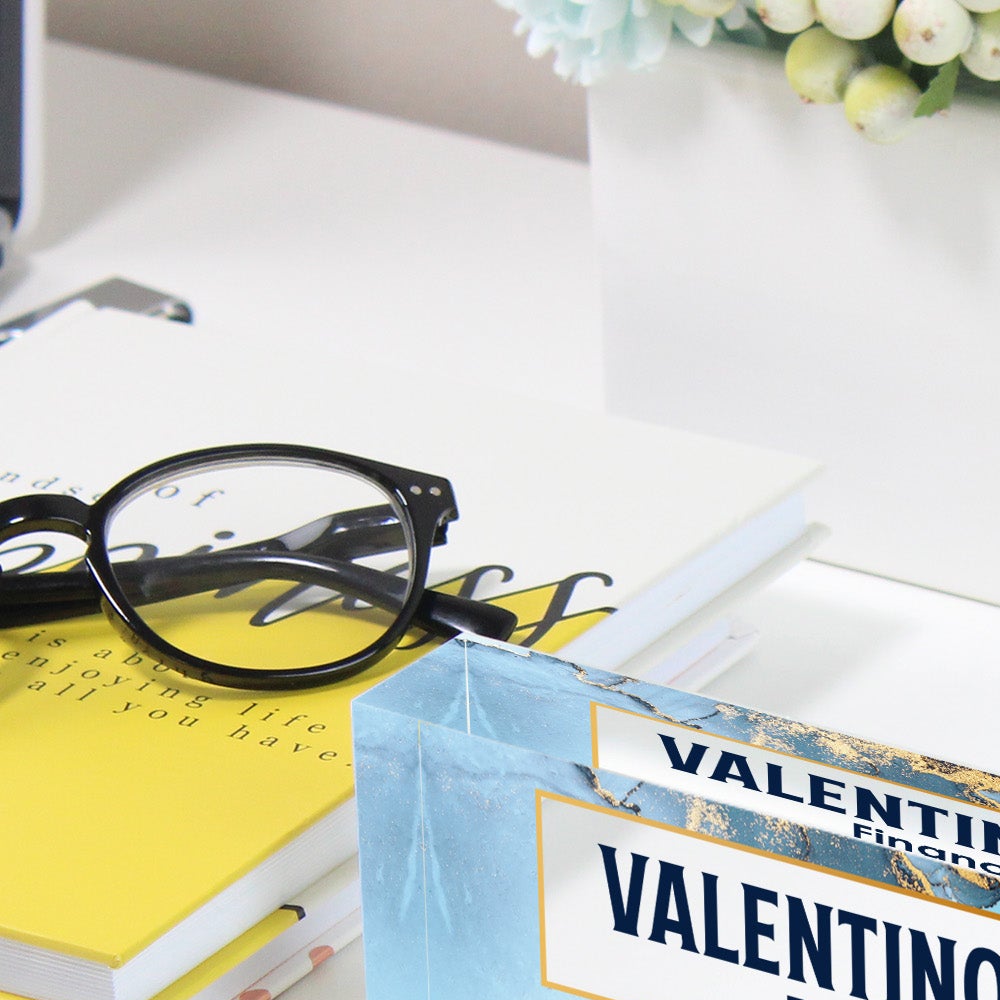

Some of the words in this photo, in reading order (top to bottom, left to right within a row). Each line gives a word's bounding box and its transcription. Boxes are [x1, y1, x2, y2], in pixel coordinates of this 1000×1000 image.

[155, 485, 225, 508] of
[27, 629, 67, 648] is
[1, 650, 210, 709] enjoying
[238, 702, 327, 734] life
[27, 680, 97, 702] all
[113, 701, 199, 728] you
[227, 724, 352, 767] have.
